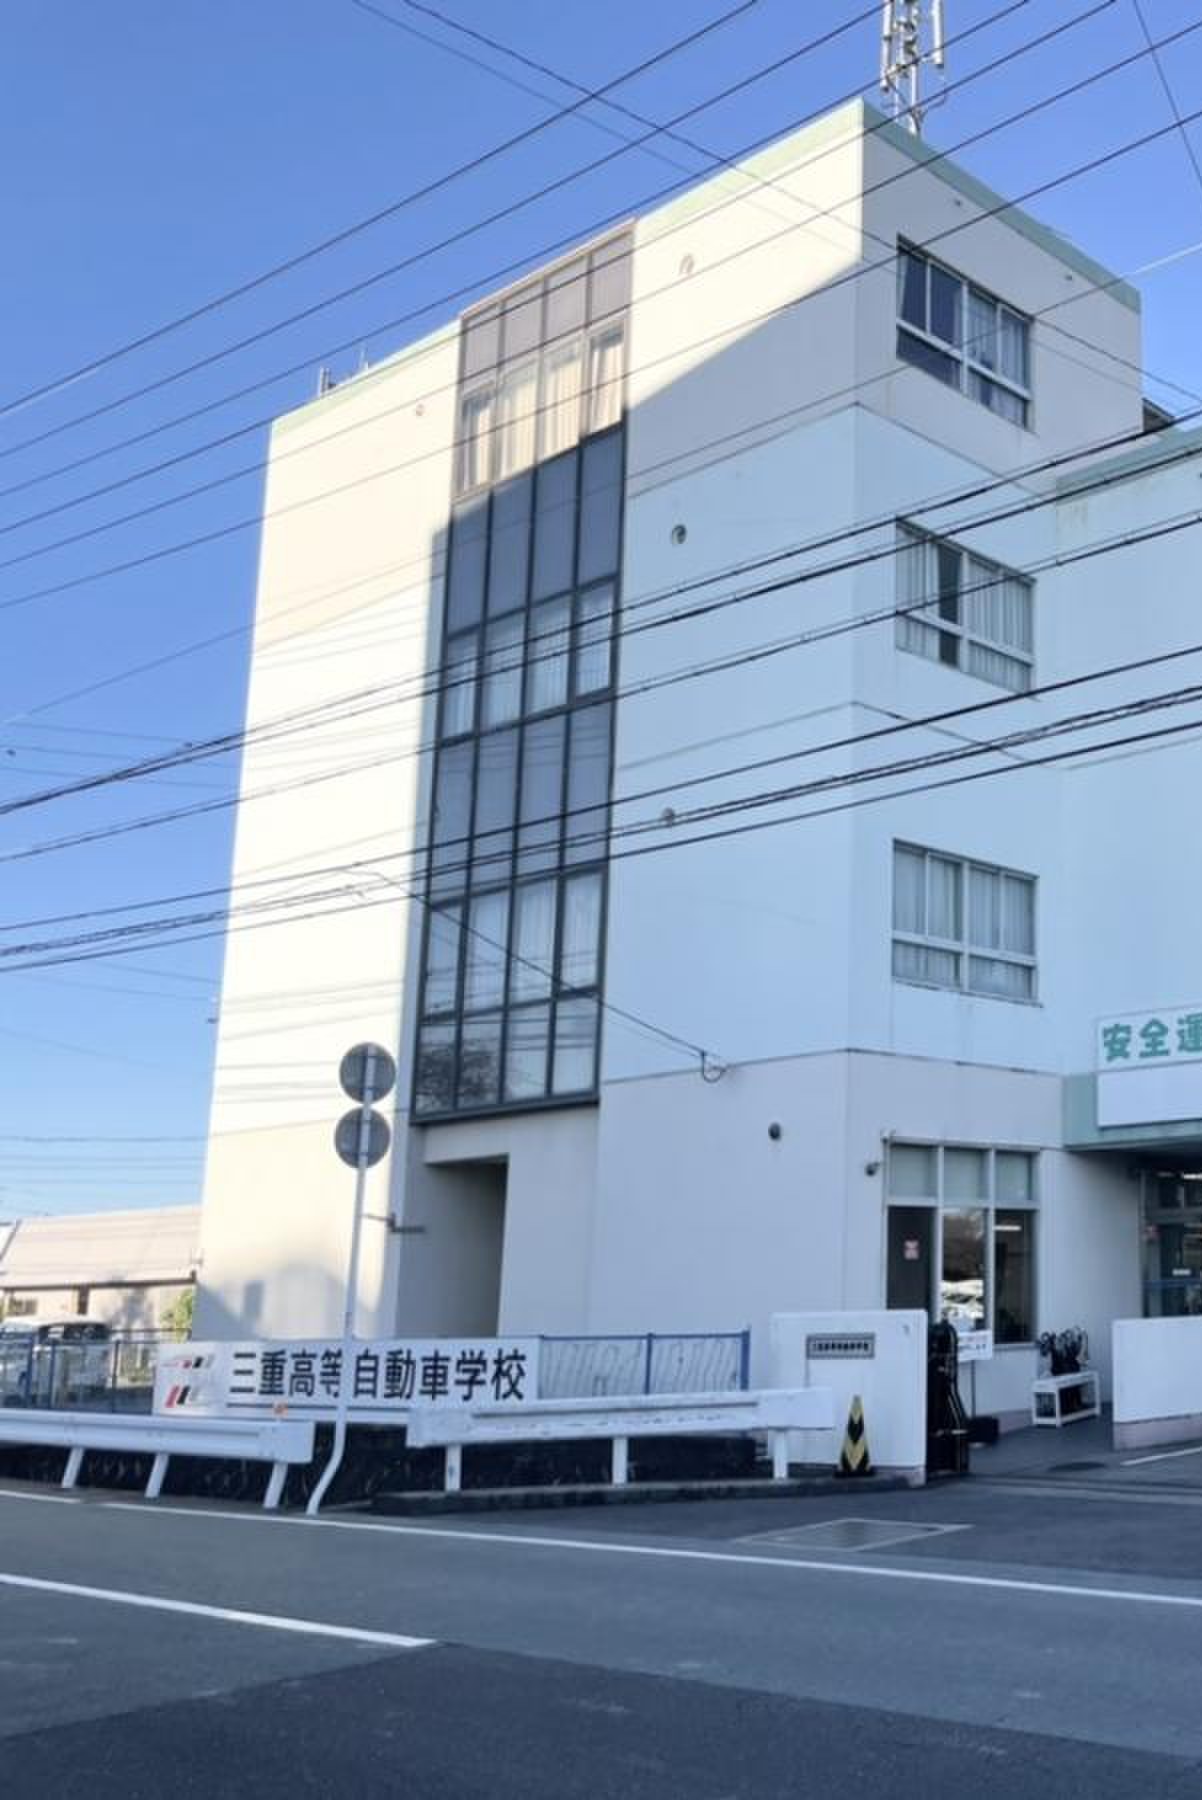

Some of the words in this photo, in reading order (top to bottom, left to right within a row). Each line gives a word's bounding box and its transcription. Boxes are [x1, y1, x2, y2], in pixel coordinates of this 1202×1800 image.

[229, 1348, 528, 1402] 三重高等自動車学校
